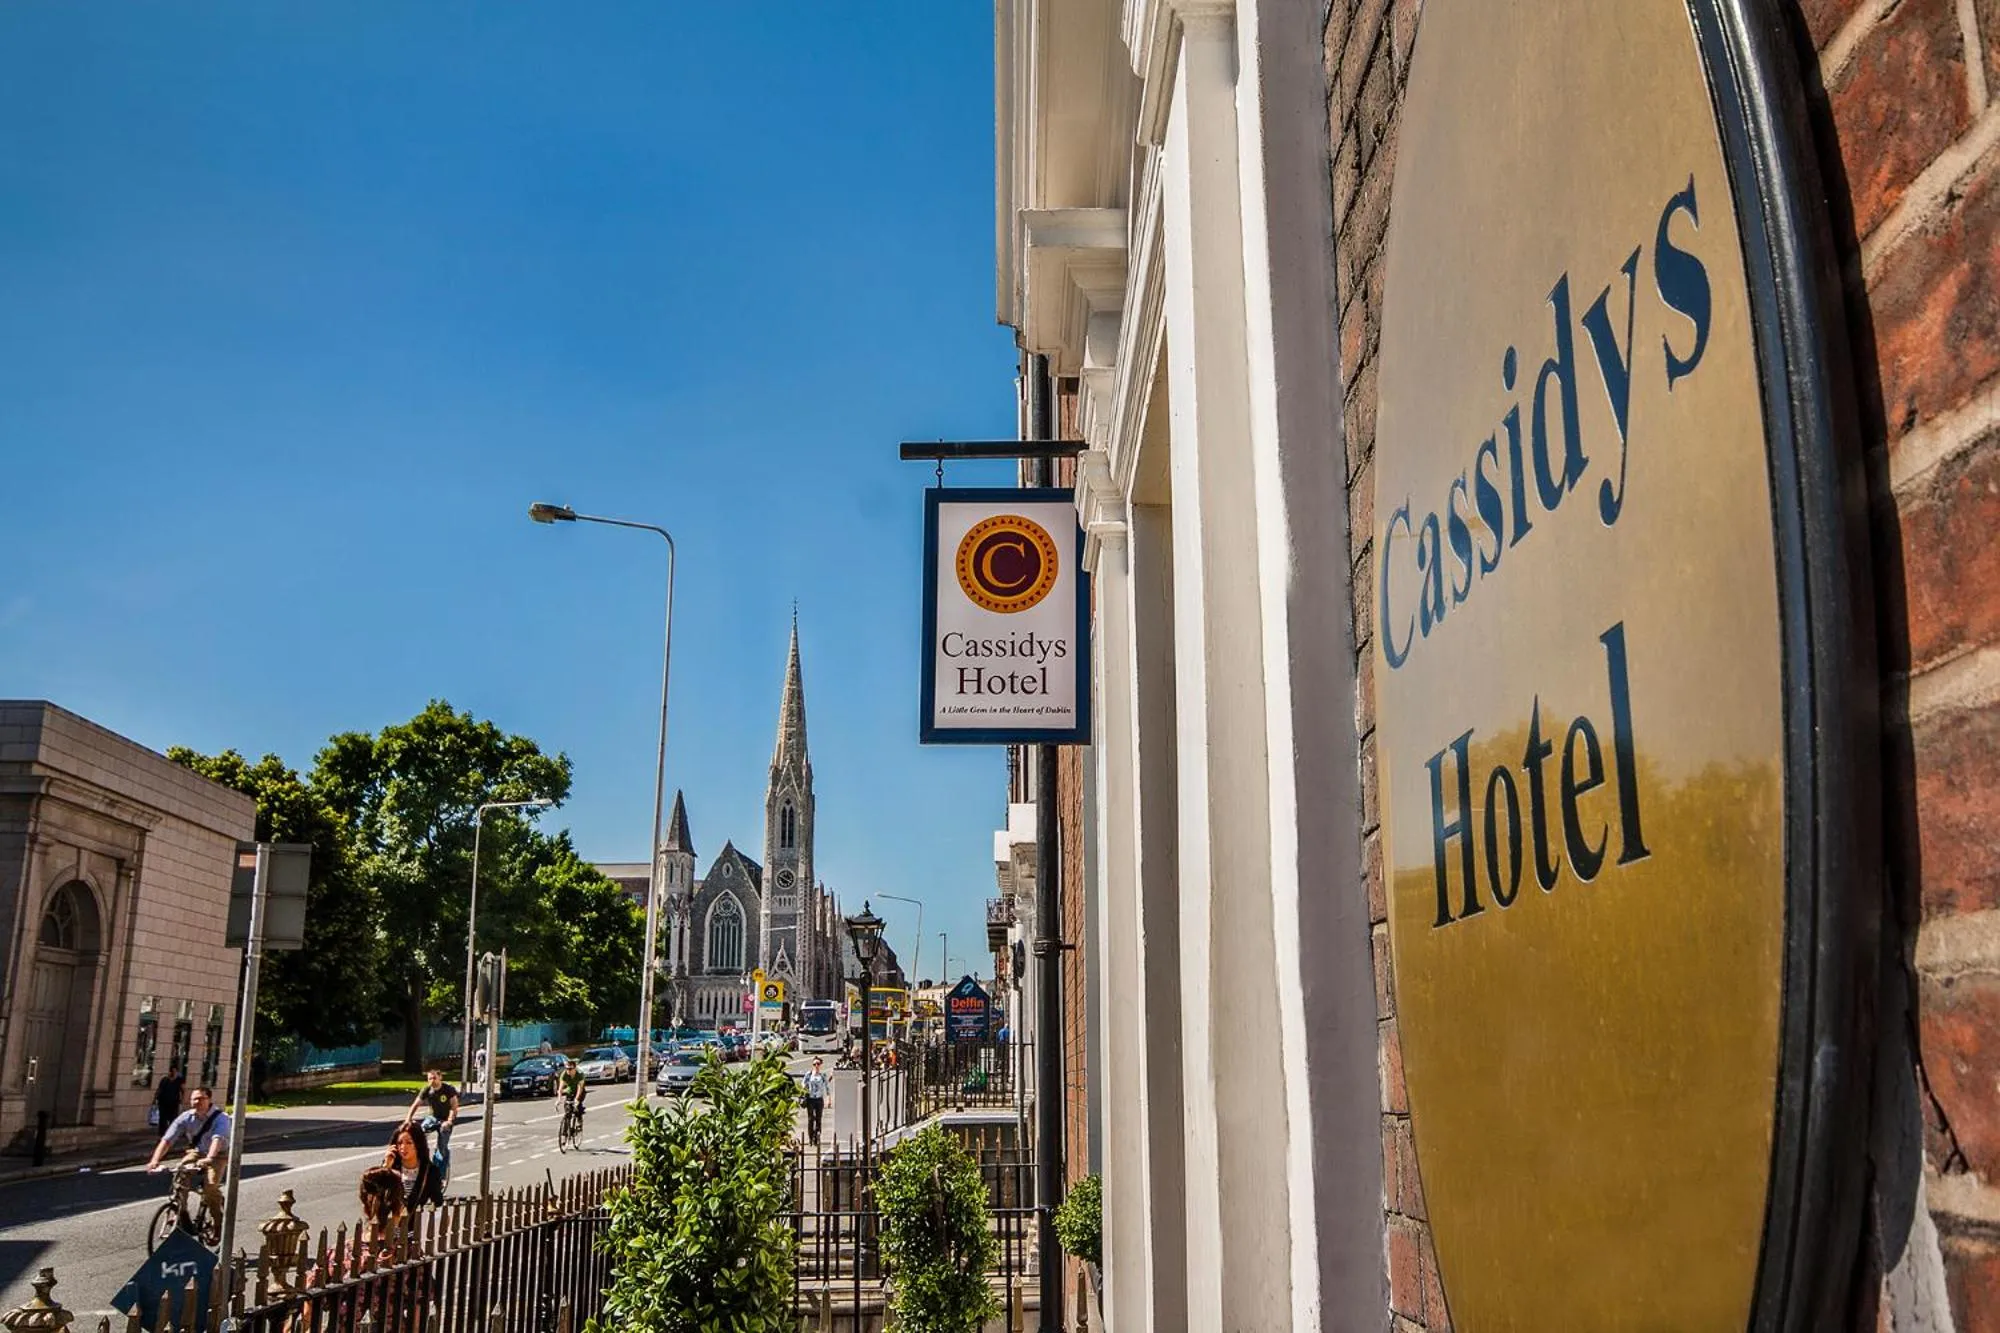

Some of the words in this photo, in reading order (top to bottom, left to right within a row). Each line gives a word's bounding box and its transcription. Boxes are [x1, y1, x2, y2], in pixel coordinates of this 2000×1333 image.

[1379, 172, 1712, 670] Cassidys
[982, 541, 1027, 588] C
[942, 631, 1067, 664] Cassidys
[956, 666, 1049, 695] Hotel
[939, 705, 947, 714] A
[948, 705, 968, 714] Little
[970, 705, 988, 714] Gem
[989, 705, 998, 714] in
[999, 705, 1011, 714] the
[1013, 705, 1034, 714] Heart
[1035, 705, 1044, 716] of
[1045, 705, 1071, 714] Dublin
[1424, 620, 1652, 930] Hotel
[951, 997, 985, 1009] Delfin
